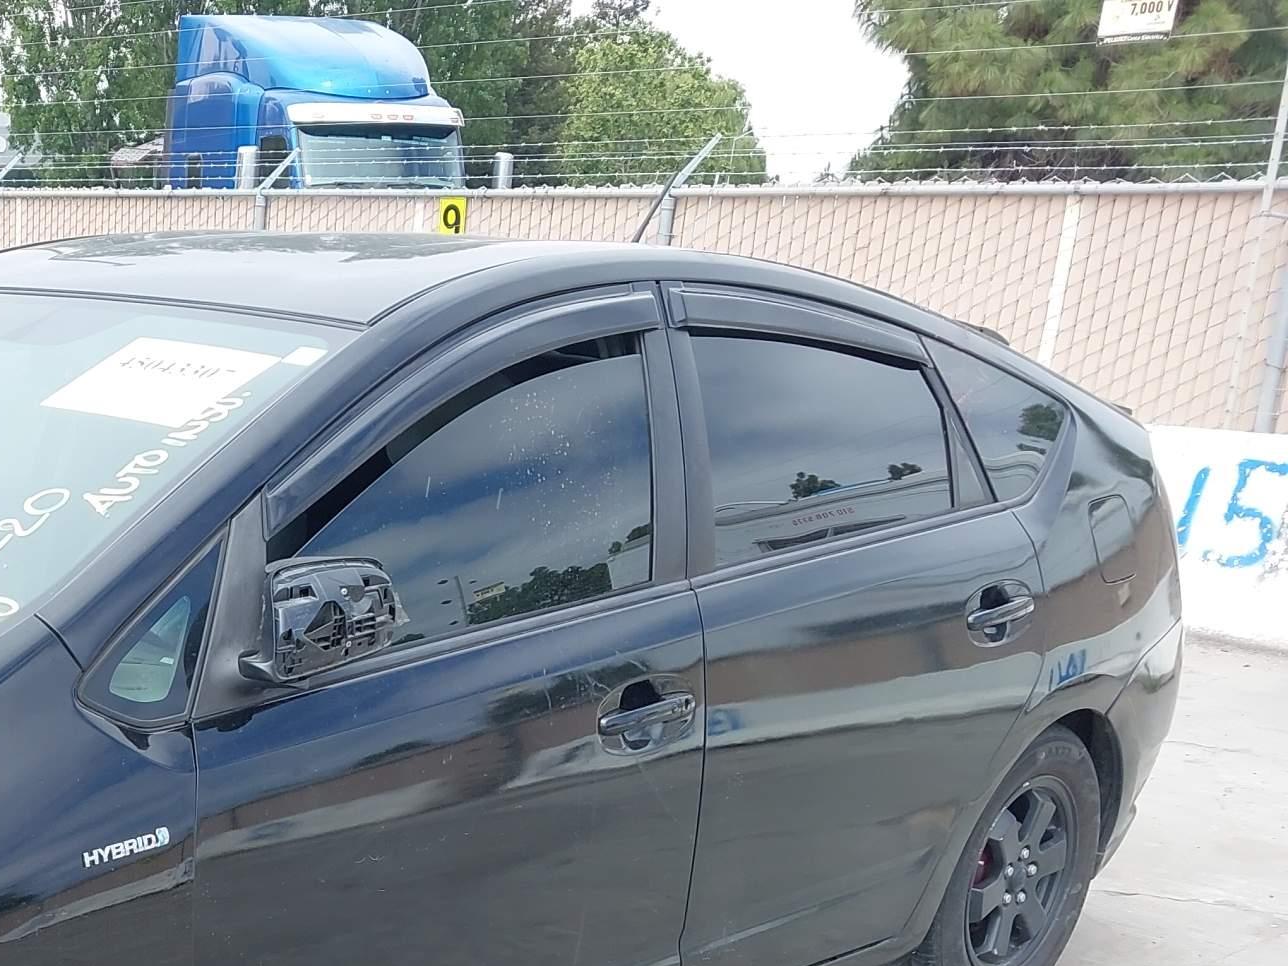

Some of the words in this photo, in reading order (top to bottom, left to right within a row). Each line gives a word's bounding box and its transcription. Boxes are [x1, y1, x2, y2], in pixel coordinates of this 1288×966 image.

[1131, 0, 1164, 16] 7,000
[1167, 0, 1175, 12] V
[443, 204, 461, 234] 9
[83, 449, 169, 518] AUTO
[1177, 459, 1288, 567] 15
[83, 833, 158, 868] HYBRID
